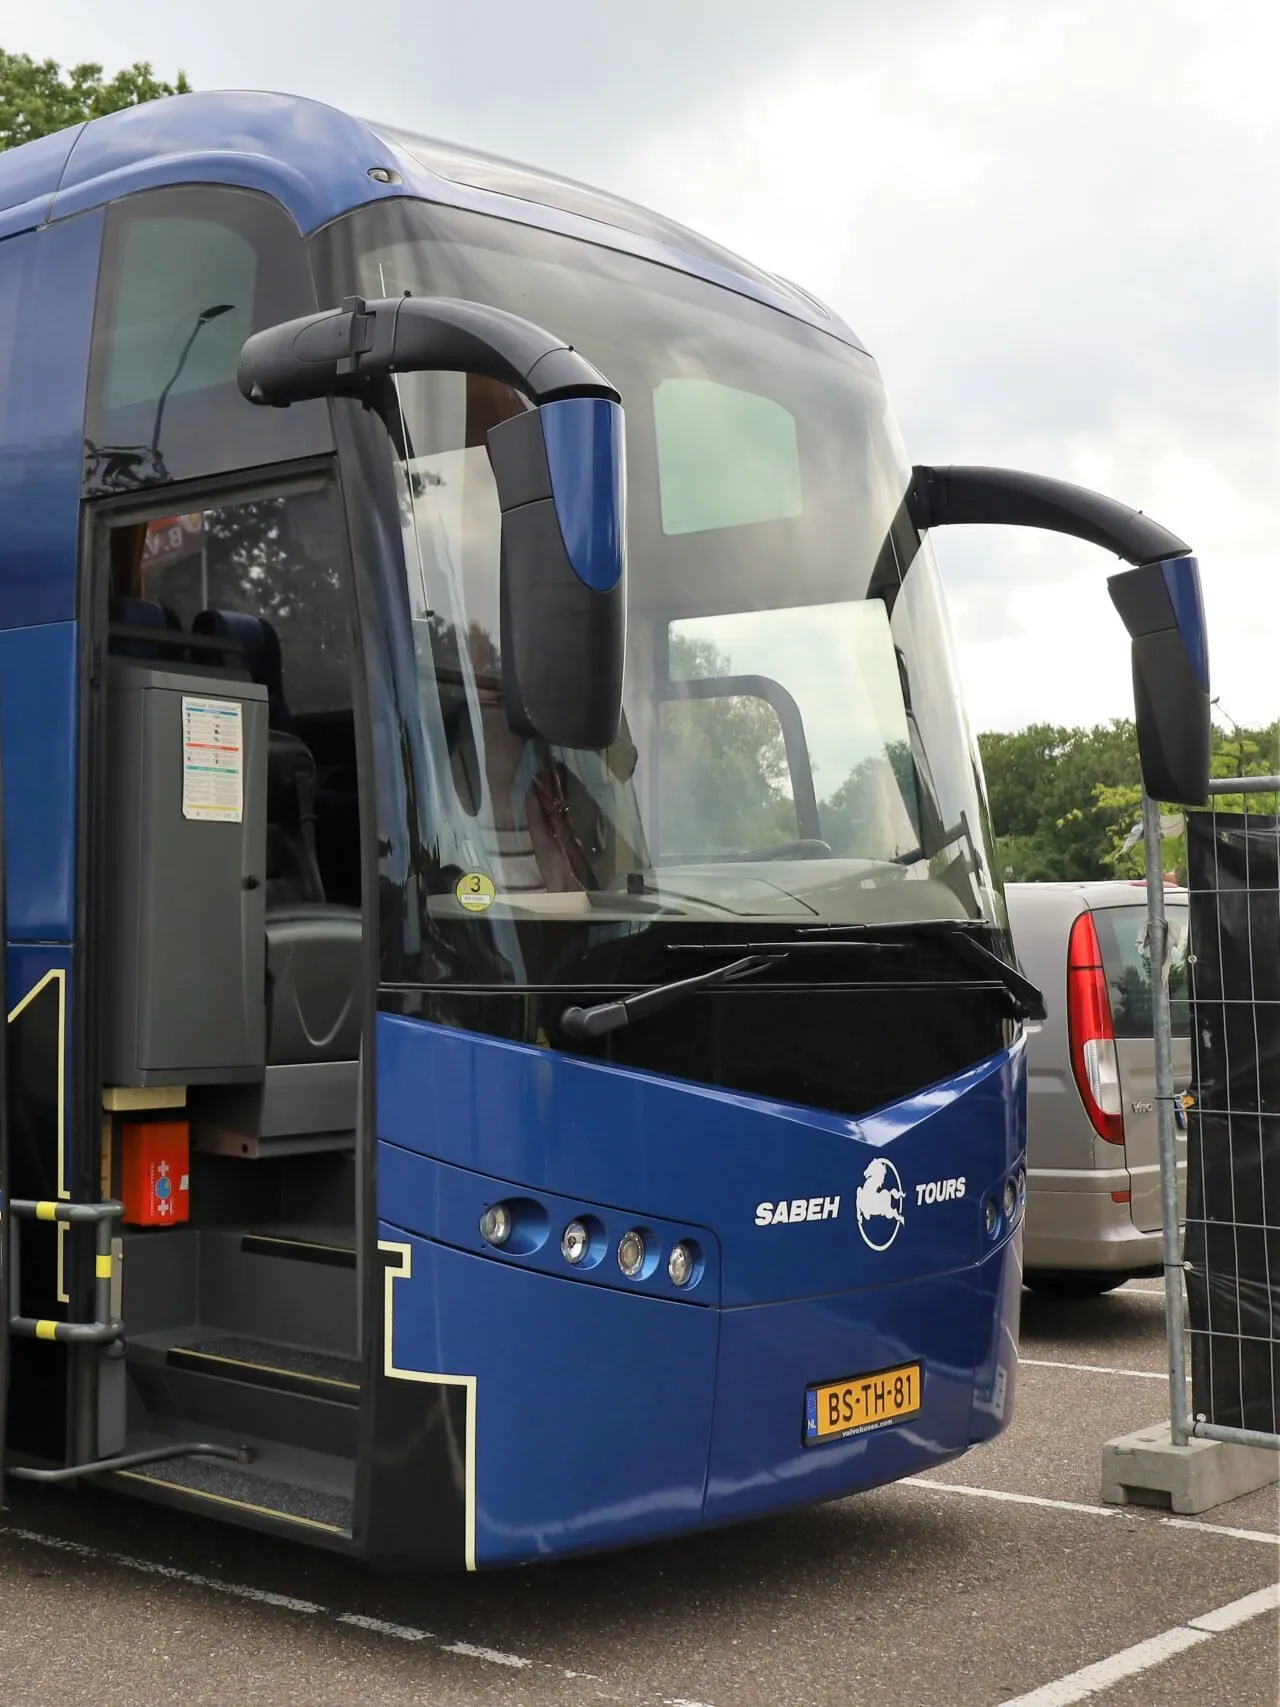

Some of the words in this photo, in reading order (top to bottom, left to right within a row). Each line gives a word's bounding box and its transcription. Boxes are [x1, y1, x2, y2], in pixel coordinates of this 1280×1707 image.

[470, 875, 481, 893] 3
[754, 1196, 841, 1227] SABEH
[915, 1176, 967, 1206] TOURS
[828, 1374, 912, 1427] BS-TH-81
[807, 1418, 817, 1431] NL
[841, 1418, 893, 1438] volvobuses.com
